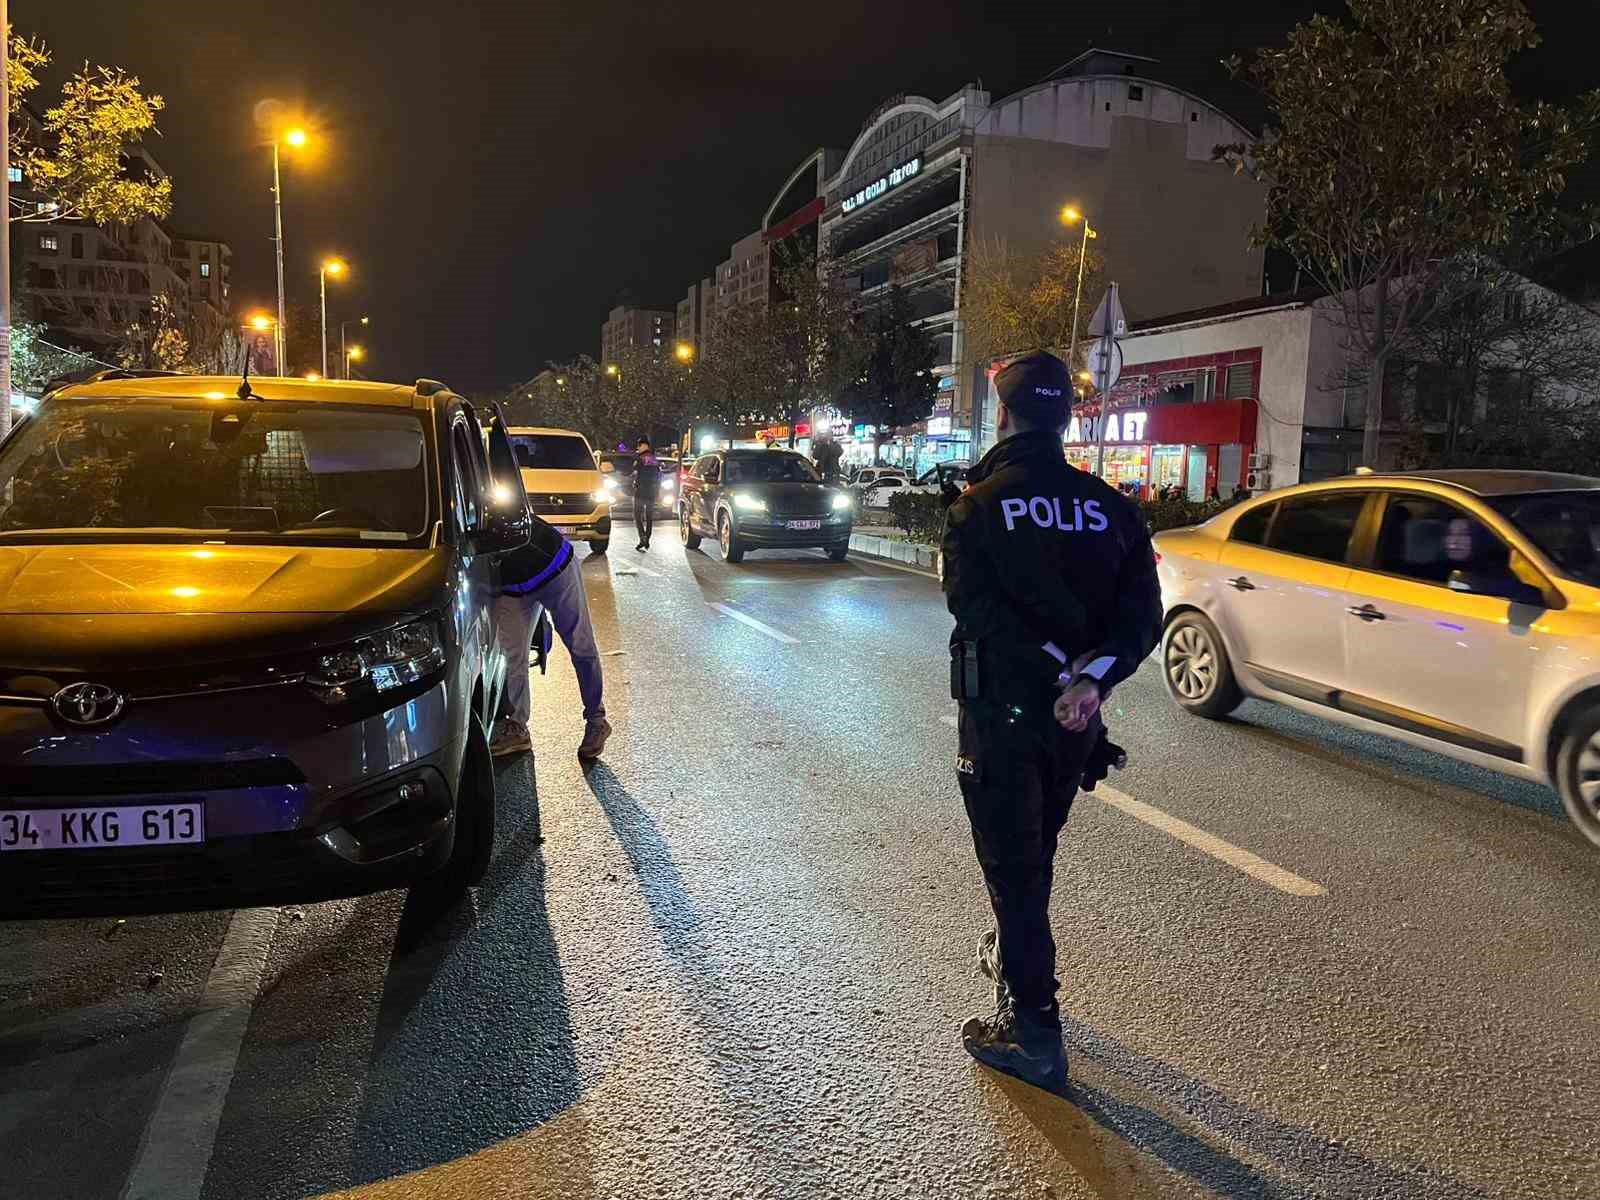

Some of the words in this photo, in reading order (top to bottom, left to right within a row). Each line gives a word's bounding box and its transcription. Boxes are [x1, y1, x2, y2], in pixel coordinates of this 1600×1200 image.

[865, 178, 886, 200] GOLD
[2, 814, 39, 845] 34
[61, 811, 120, 844] KKG
[142, 808, 195, 840] 613
